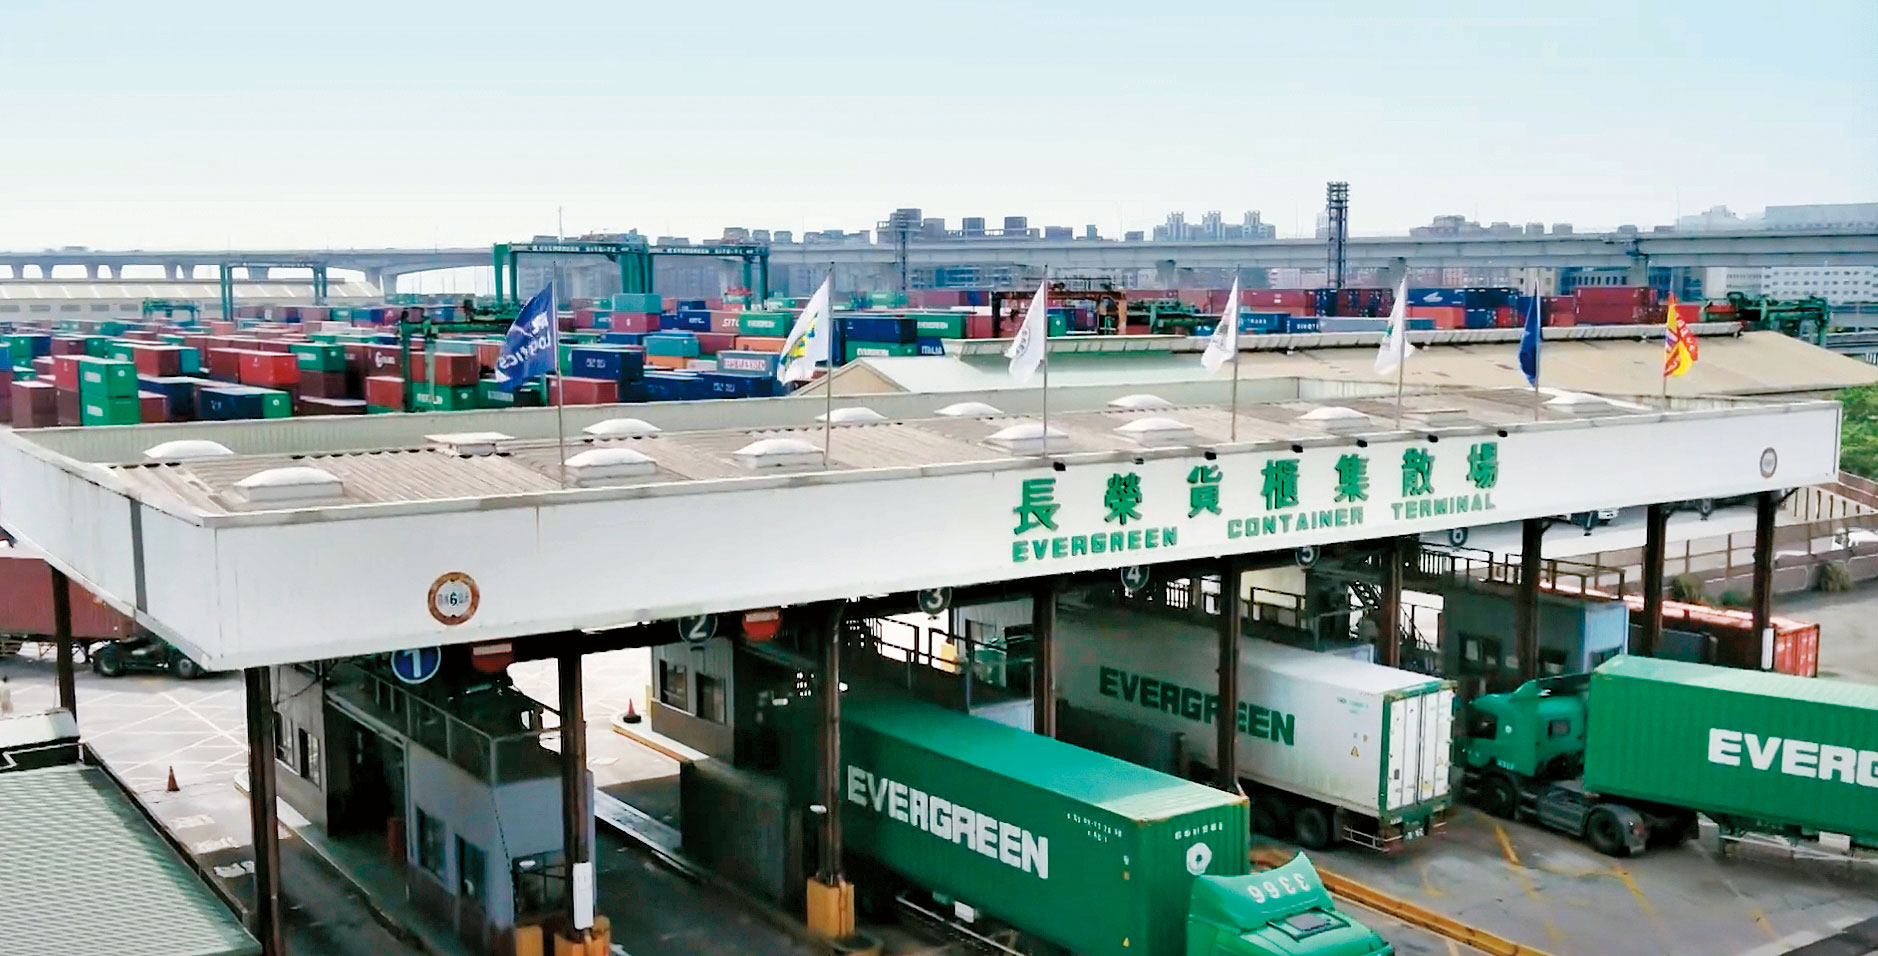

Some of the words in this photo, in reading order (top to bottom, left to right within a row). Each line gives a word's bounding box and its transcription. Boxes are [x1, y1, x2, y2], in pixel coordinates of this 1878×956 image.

[1013, 441, 1500, 535] 長榮貨櫃集散場
[1011, 526, 1178, 562] EVERGREEN
[1227, 505, 1364, 539] CONTAINER
[1391, 492, 1496, 520] TERMINAL
[1127, 565, 1141, 584] 4
[926, 587, 944, 609] 3
[689, 614, 707, 639] 2
[402, 649, 421, 678] 1
[846, 764, 1049, 879] EVERGREEN
[1247, 872, 1311, 904] 3366
